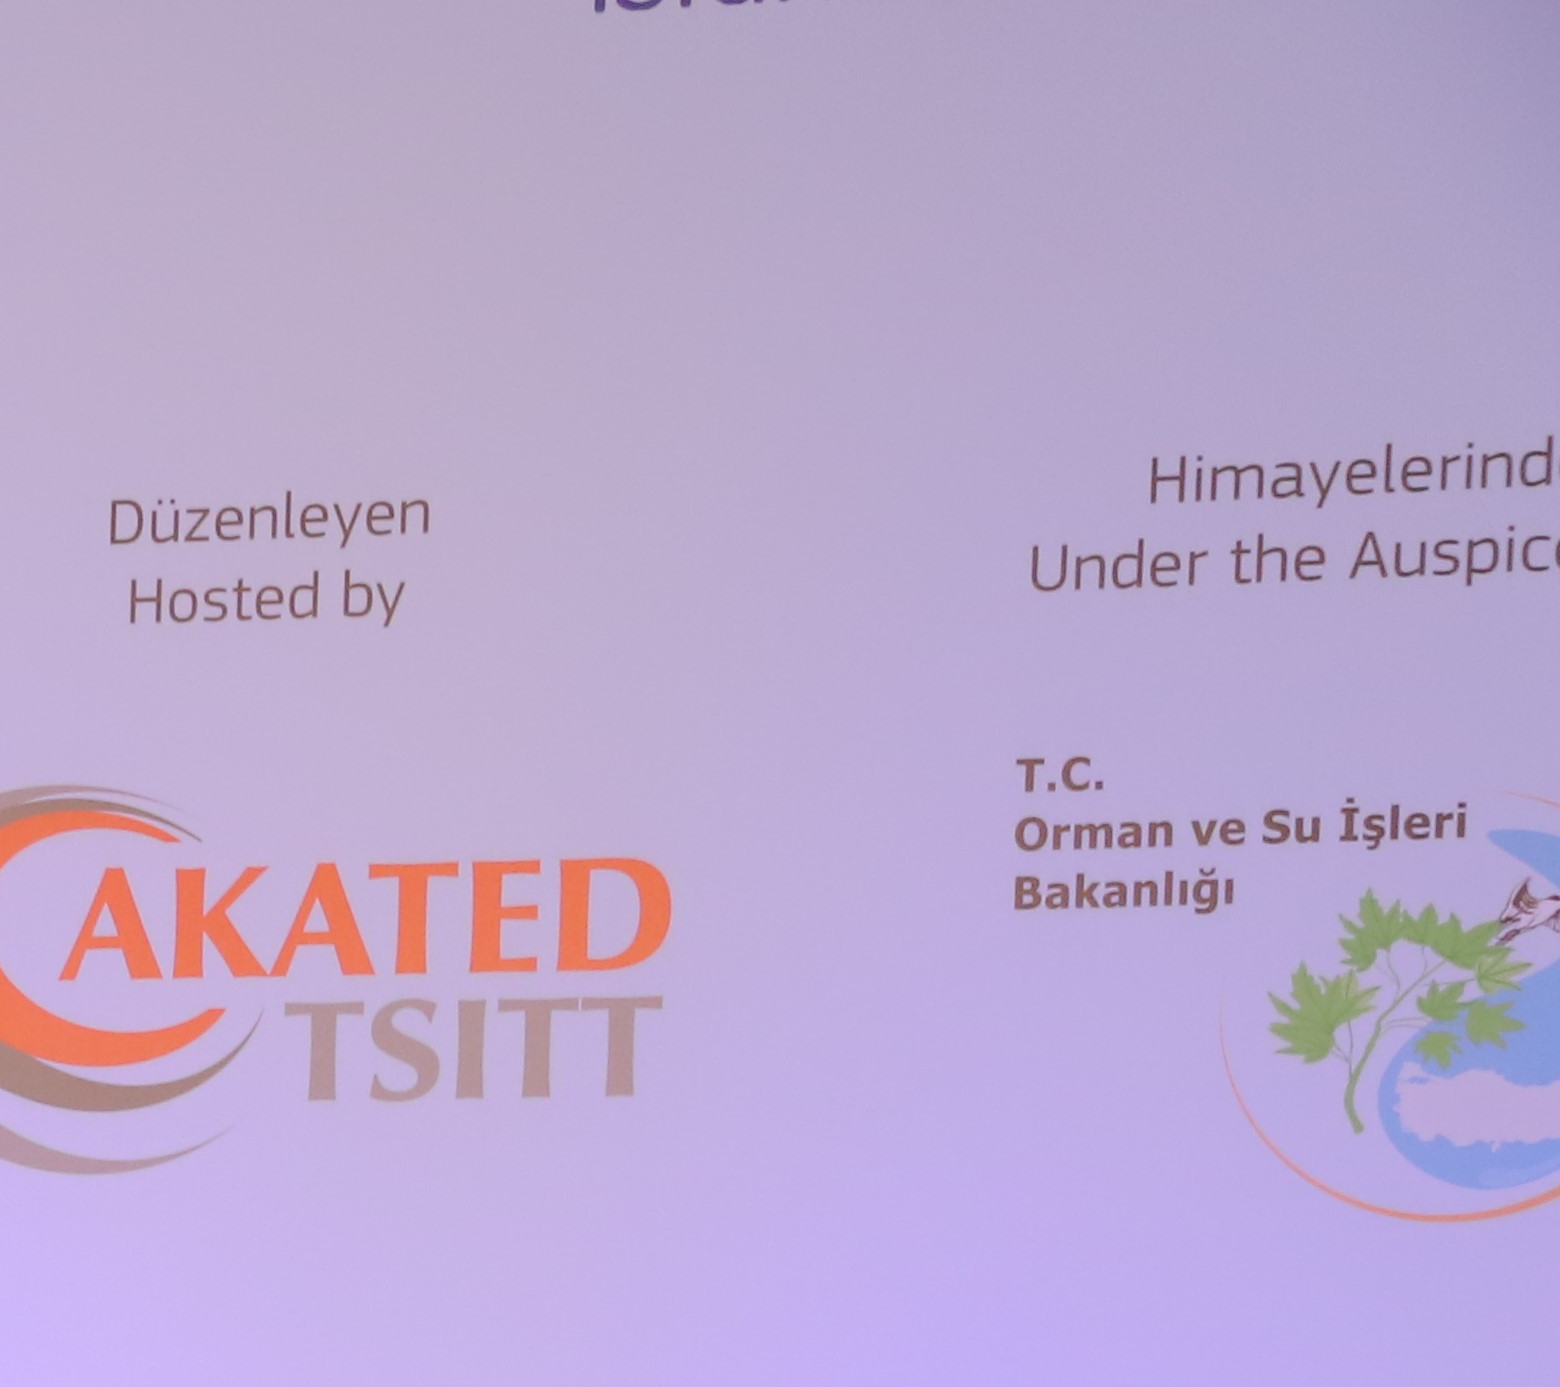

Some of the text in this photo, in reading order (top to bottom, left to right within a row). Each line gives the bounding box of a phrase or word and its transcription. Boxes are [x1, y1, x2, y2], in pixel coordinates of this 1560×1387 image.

[1148, 436, 1560, 510] Himayelerind
[109, 490, 433, 547] Düzenleyen
[1029, 521, 1560, 597] Under the Auspic
[129, 571, 406, 628] Hosted by
[1016, 756, 1107, 794] T.C.
[1013, 801, 1470, 854] Orman ve Su İşleri
[1013, 868, 1236, 912] Bakanlığı
[57, 856, 673, 982] AKATED
[283, 994, 664, 1102] TSITT
